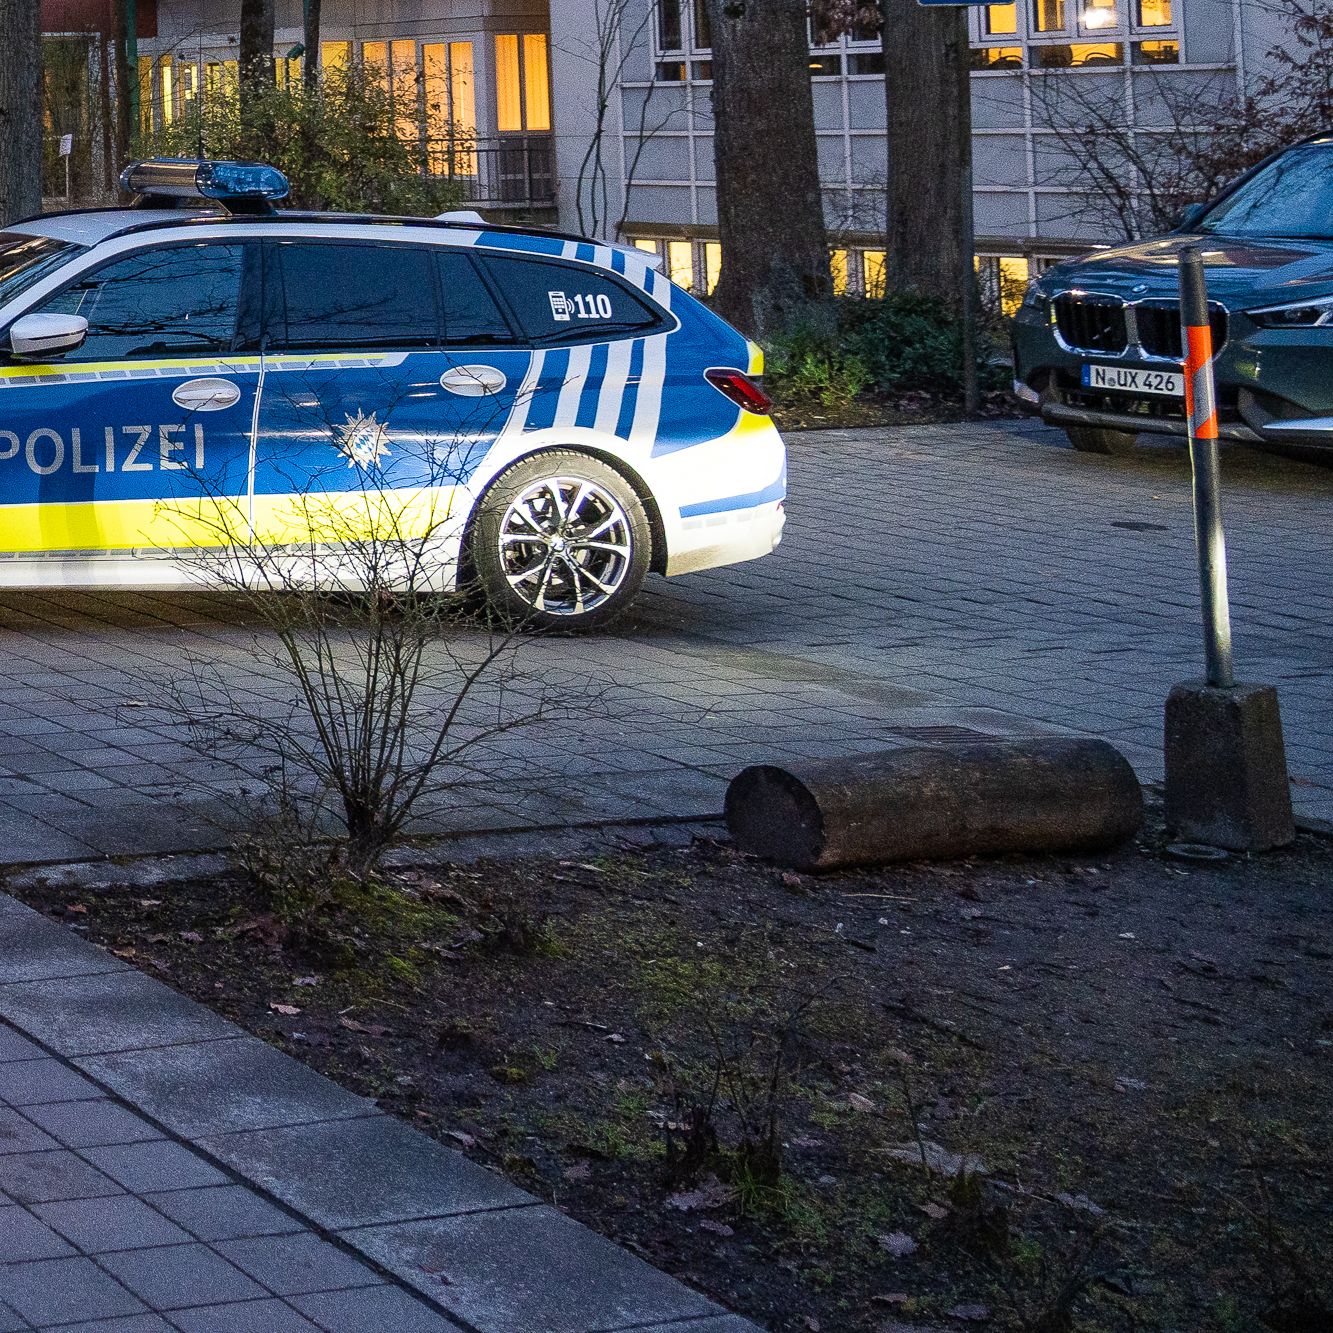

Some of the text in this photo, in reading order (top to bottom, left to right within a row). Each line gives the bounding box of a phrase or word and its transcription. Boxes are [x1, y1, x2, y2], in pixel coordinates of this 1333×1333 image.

[574, 294, 612, 318] 110
[1095, 368, 1175, 392] N UX 426
